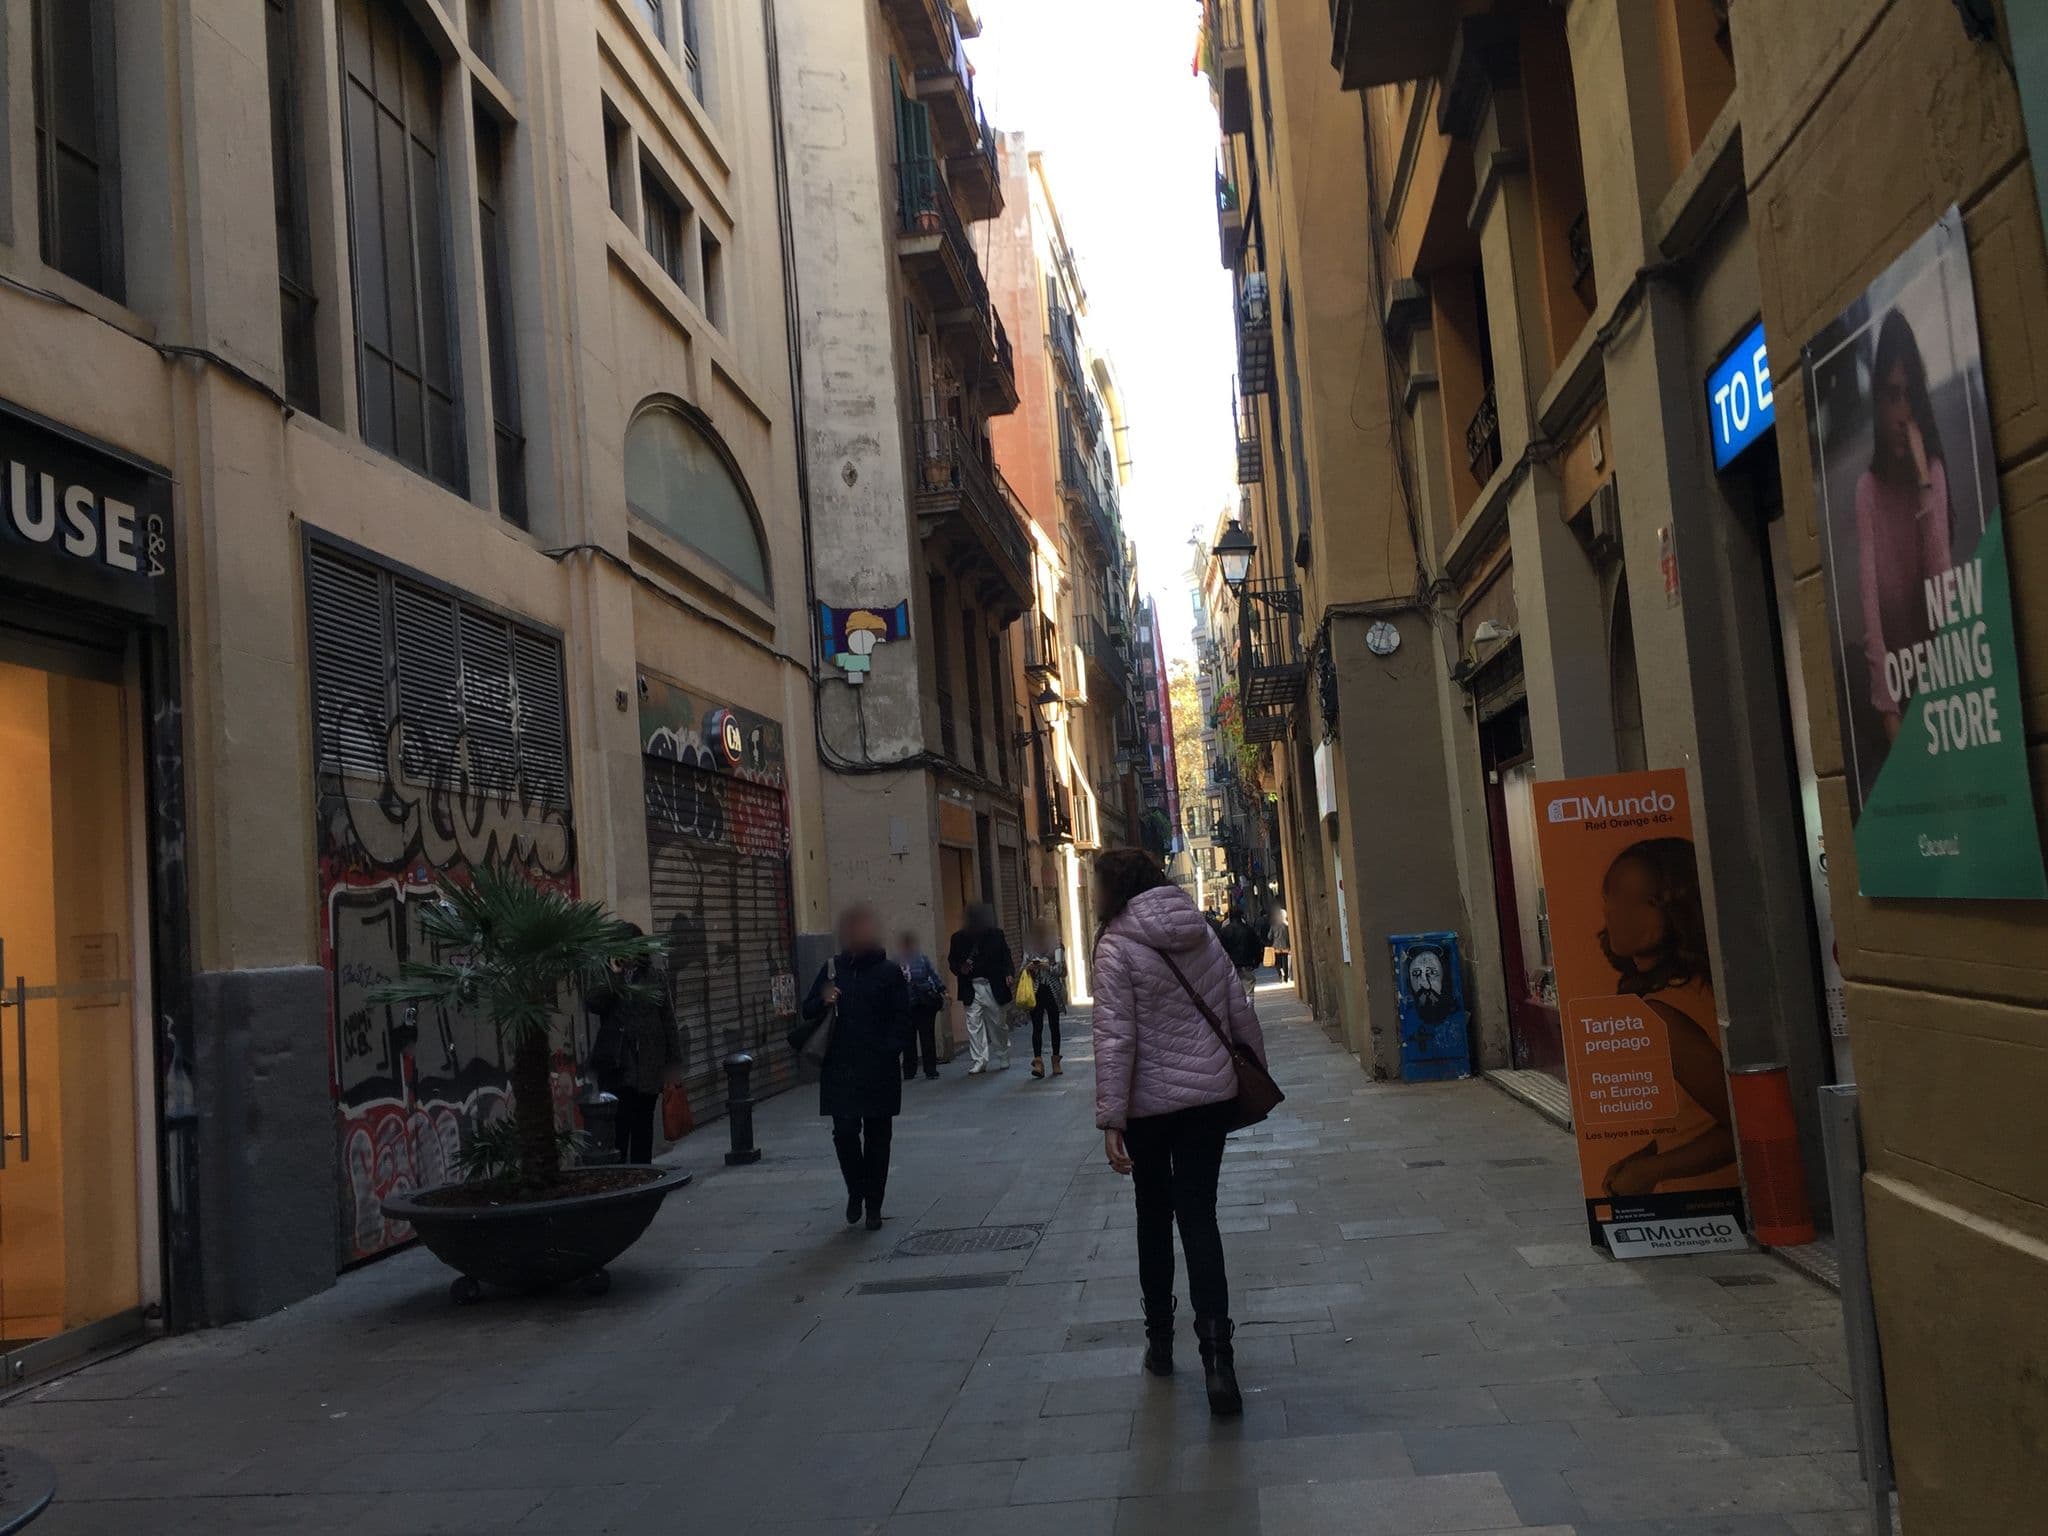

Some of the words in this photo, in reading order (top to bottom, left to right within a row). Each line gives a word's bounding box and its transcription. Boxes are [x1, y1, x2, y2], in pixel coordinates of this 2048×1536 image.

[1714, 370, 1750, 444] TO
[147, 513, 166, 577] C&A
[1924, 558, 1983, 631] NEW
[1885, 621, 1994, 704] OPENING
[1923, 687, 2001, 756] STORE
[1582, 790, 1675, 819] Mundo
[1585, 821, 1607, 831] Red
[1610, 816, 1650, 829] Orange
[1652, 814, 1674, 824] 4G+
[1581, 1016, 1644, 1035] Tarjeta
[1585, 1036, 1651, 1055] prepago
[1592, 1070, 1653, 1085] Roaming
[1590, 1089, 1606, 1100] en
[1611, 1085, 1660, 1098] Europa
[1599, 1099, 1654, 1113] incluido
[1585, 1131, 1602, 1140] Los
[1646, 1223, 1733, 1241] Mundo
[1651, 1241, 1671, 1249] Red
[1674, 1239, 1711, 1248] Orange
